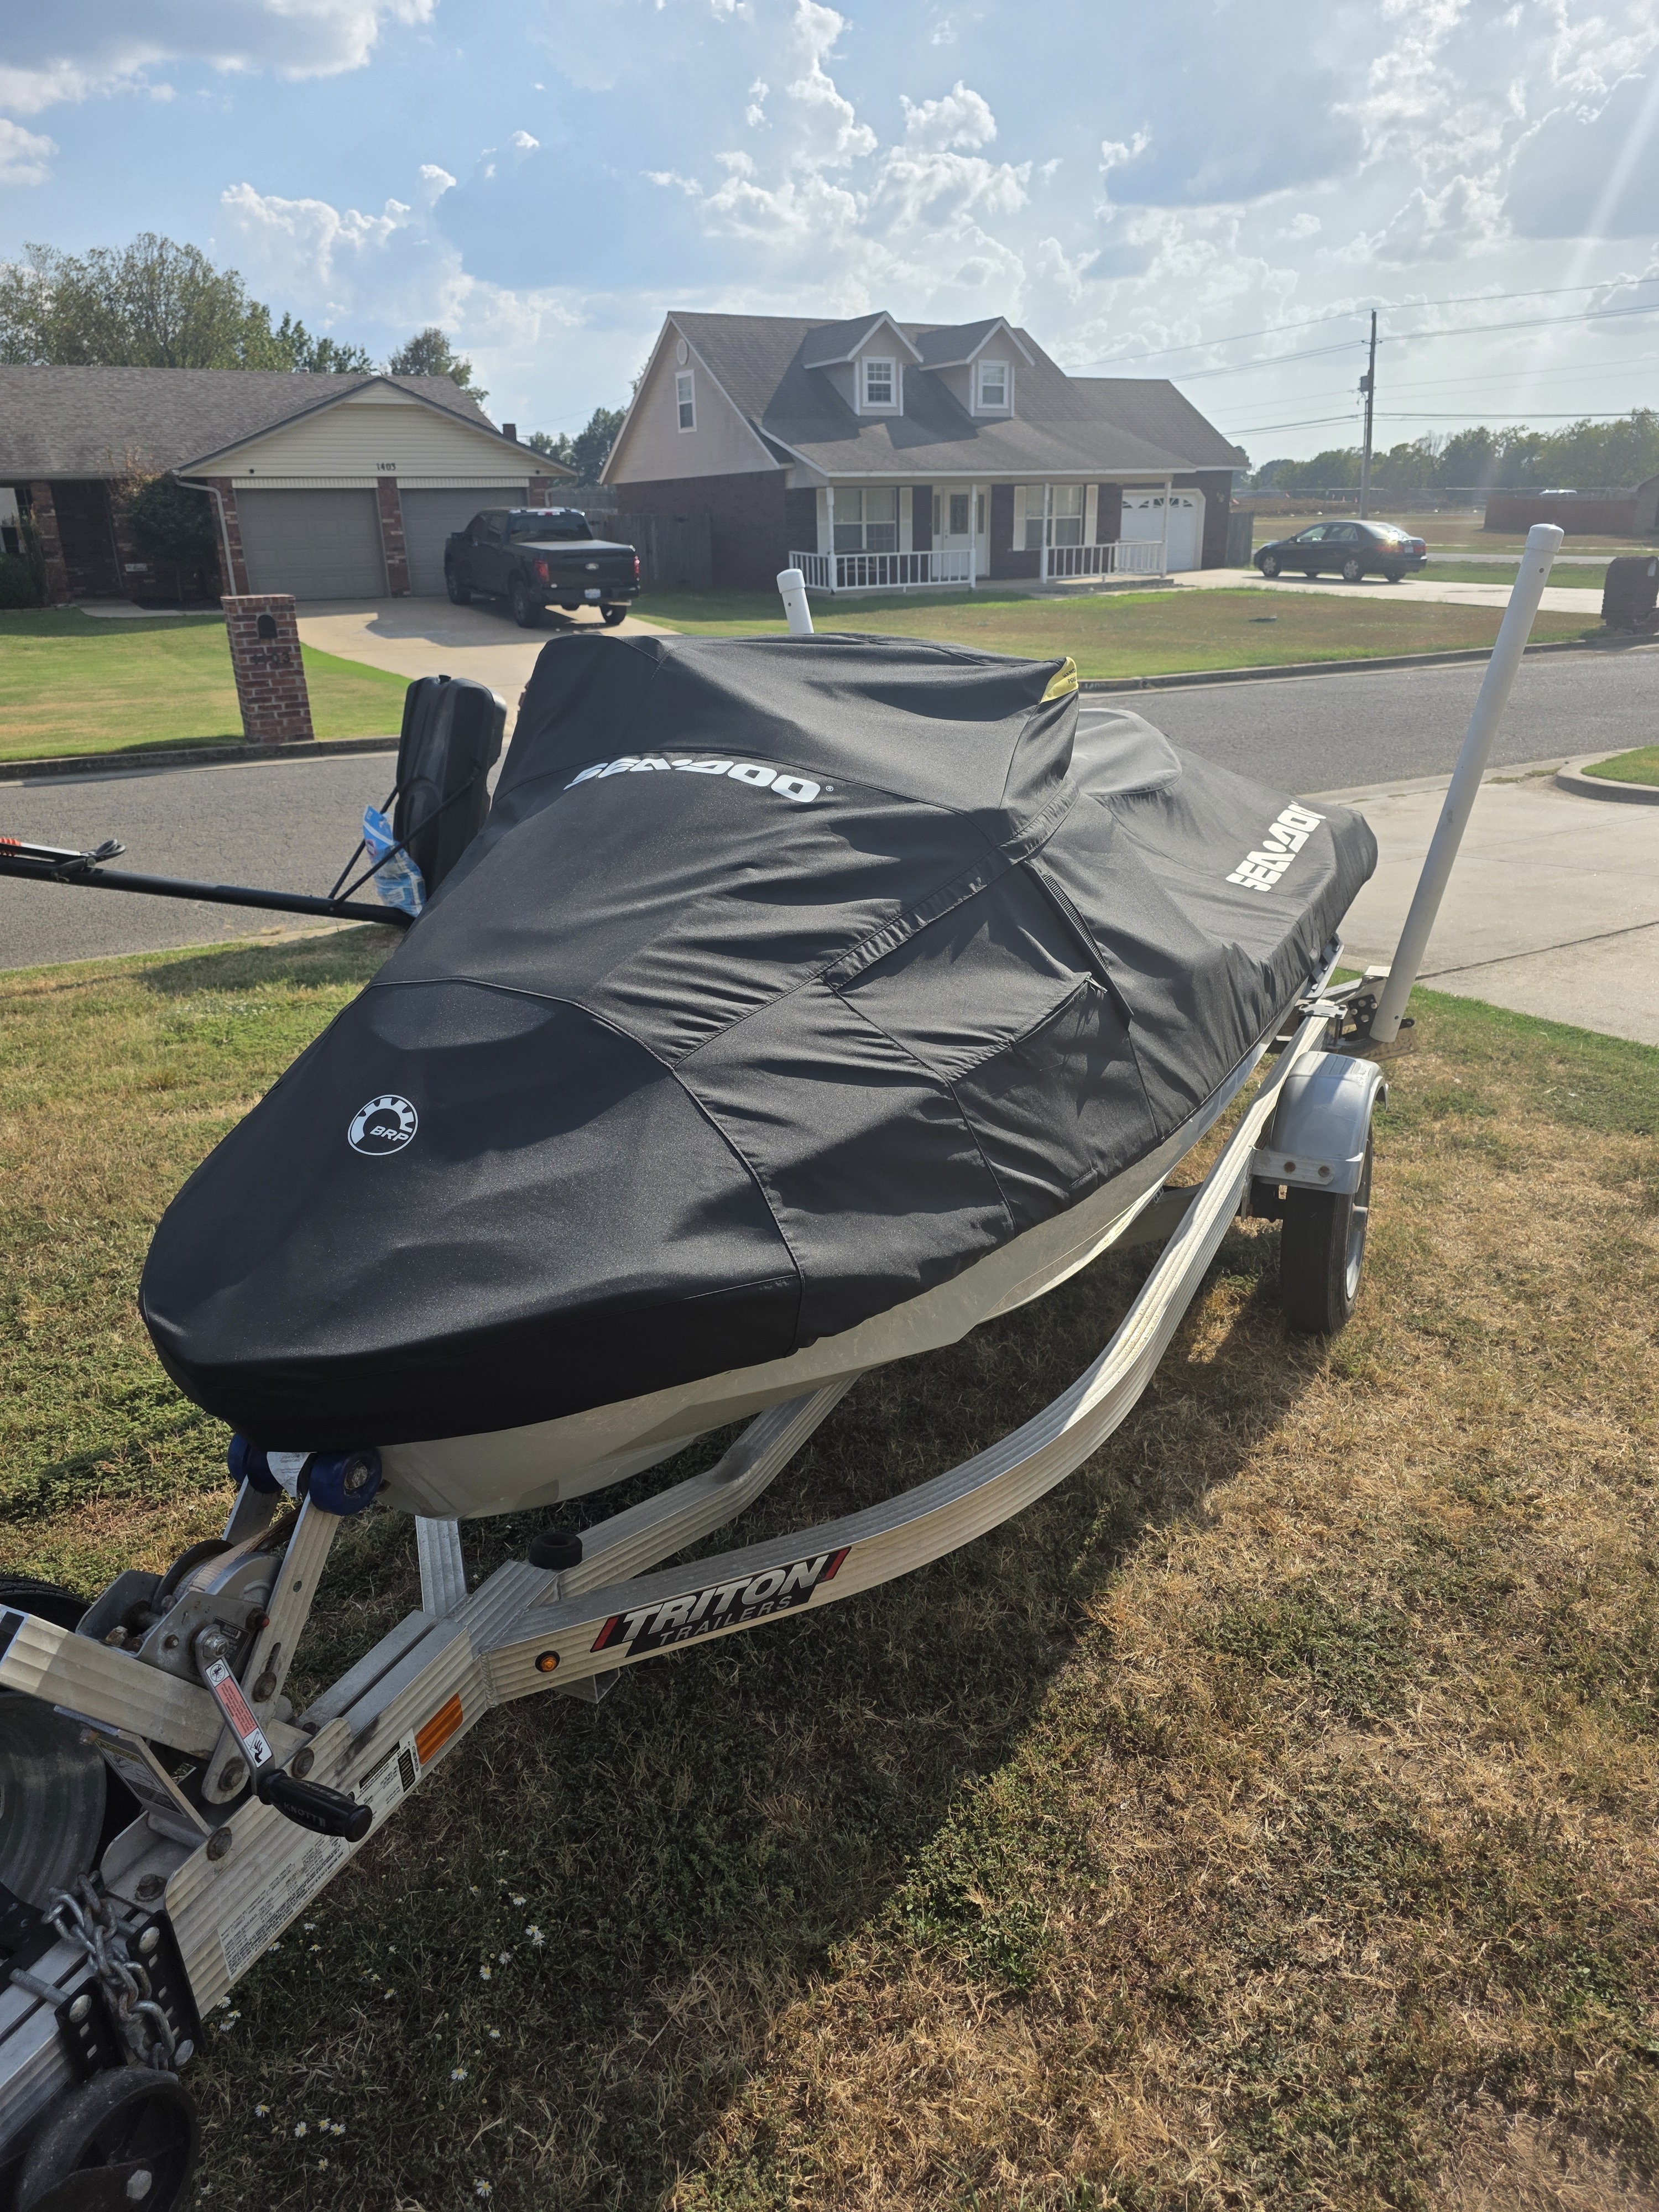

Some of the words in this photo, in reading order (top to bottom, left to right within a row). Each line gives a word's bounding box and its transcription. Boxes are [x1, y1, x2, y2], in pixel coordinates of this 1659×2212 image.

[376, 462, 397, 471] 1403
[370, 1125, 409, 1141] BRP
[621, 1554, 830, 1642] TRITON
[659, 1595, 793, 1646] TRAILERS
[284, 1802, 316, 1822] KNOTT
